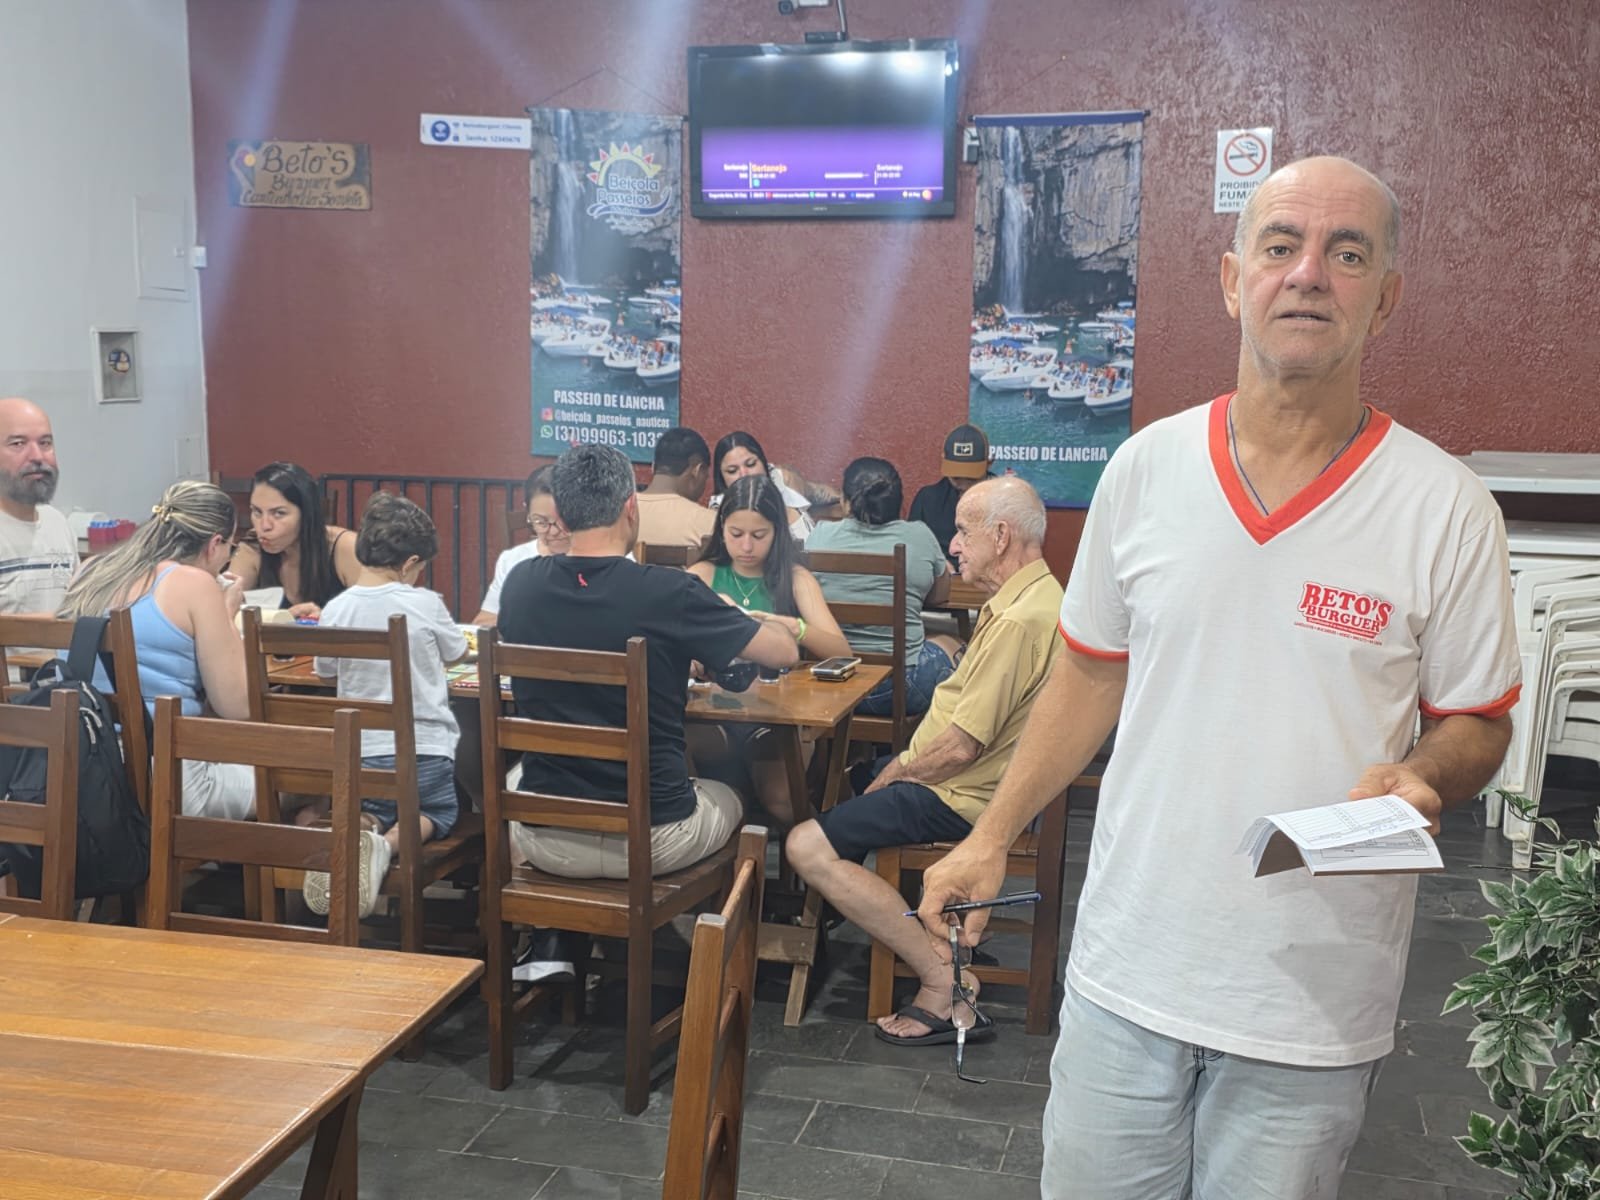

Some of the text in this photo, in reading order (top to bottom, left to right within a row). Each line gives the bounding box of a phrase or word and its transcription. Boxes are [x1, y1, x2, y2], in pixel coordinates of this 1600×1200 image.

[598, 190, 650, 206] Passeios
[554, 390, 665, 411] PASSEIO DE LANCHA
[988, 445, 1108, 462] PASSEIO DE LANCHA
[1300, 583, 1392, 627] BETO'S
[1306, 605, 1380, 632] BURGUER
